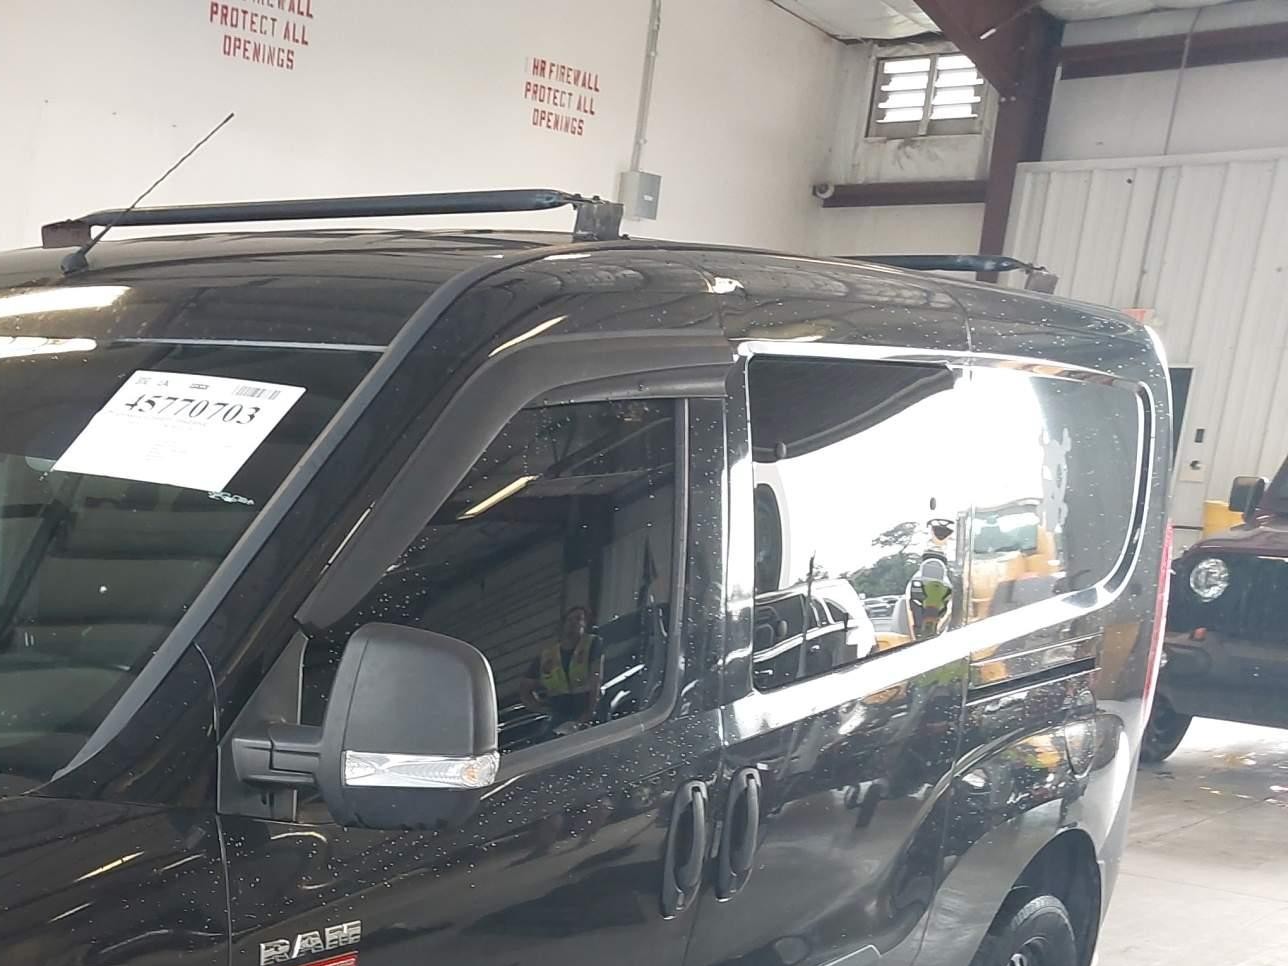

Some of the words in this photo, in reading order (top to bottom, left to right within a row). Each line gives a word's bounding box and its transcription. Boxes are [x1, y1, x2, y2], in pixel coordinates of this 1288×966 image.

[209, 2, 278, 37] PROTECT
[283, 20, 309, 46] ALL
[222, 34, 295, 70] OPENINGS
[548, 62, 600, 93] FIREWALL
[524, 81, 574, 109] PROTECT
[576, 94, 595, 116] ALL
[532, 108, 585, 136] OPENINGS
[125, 394, 261, 425] 45770703
